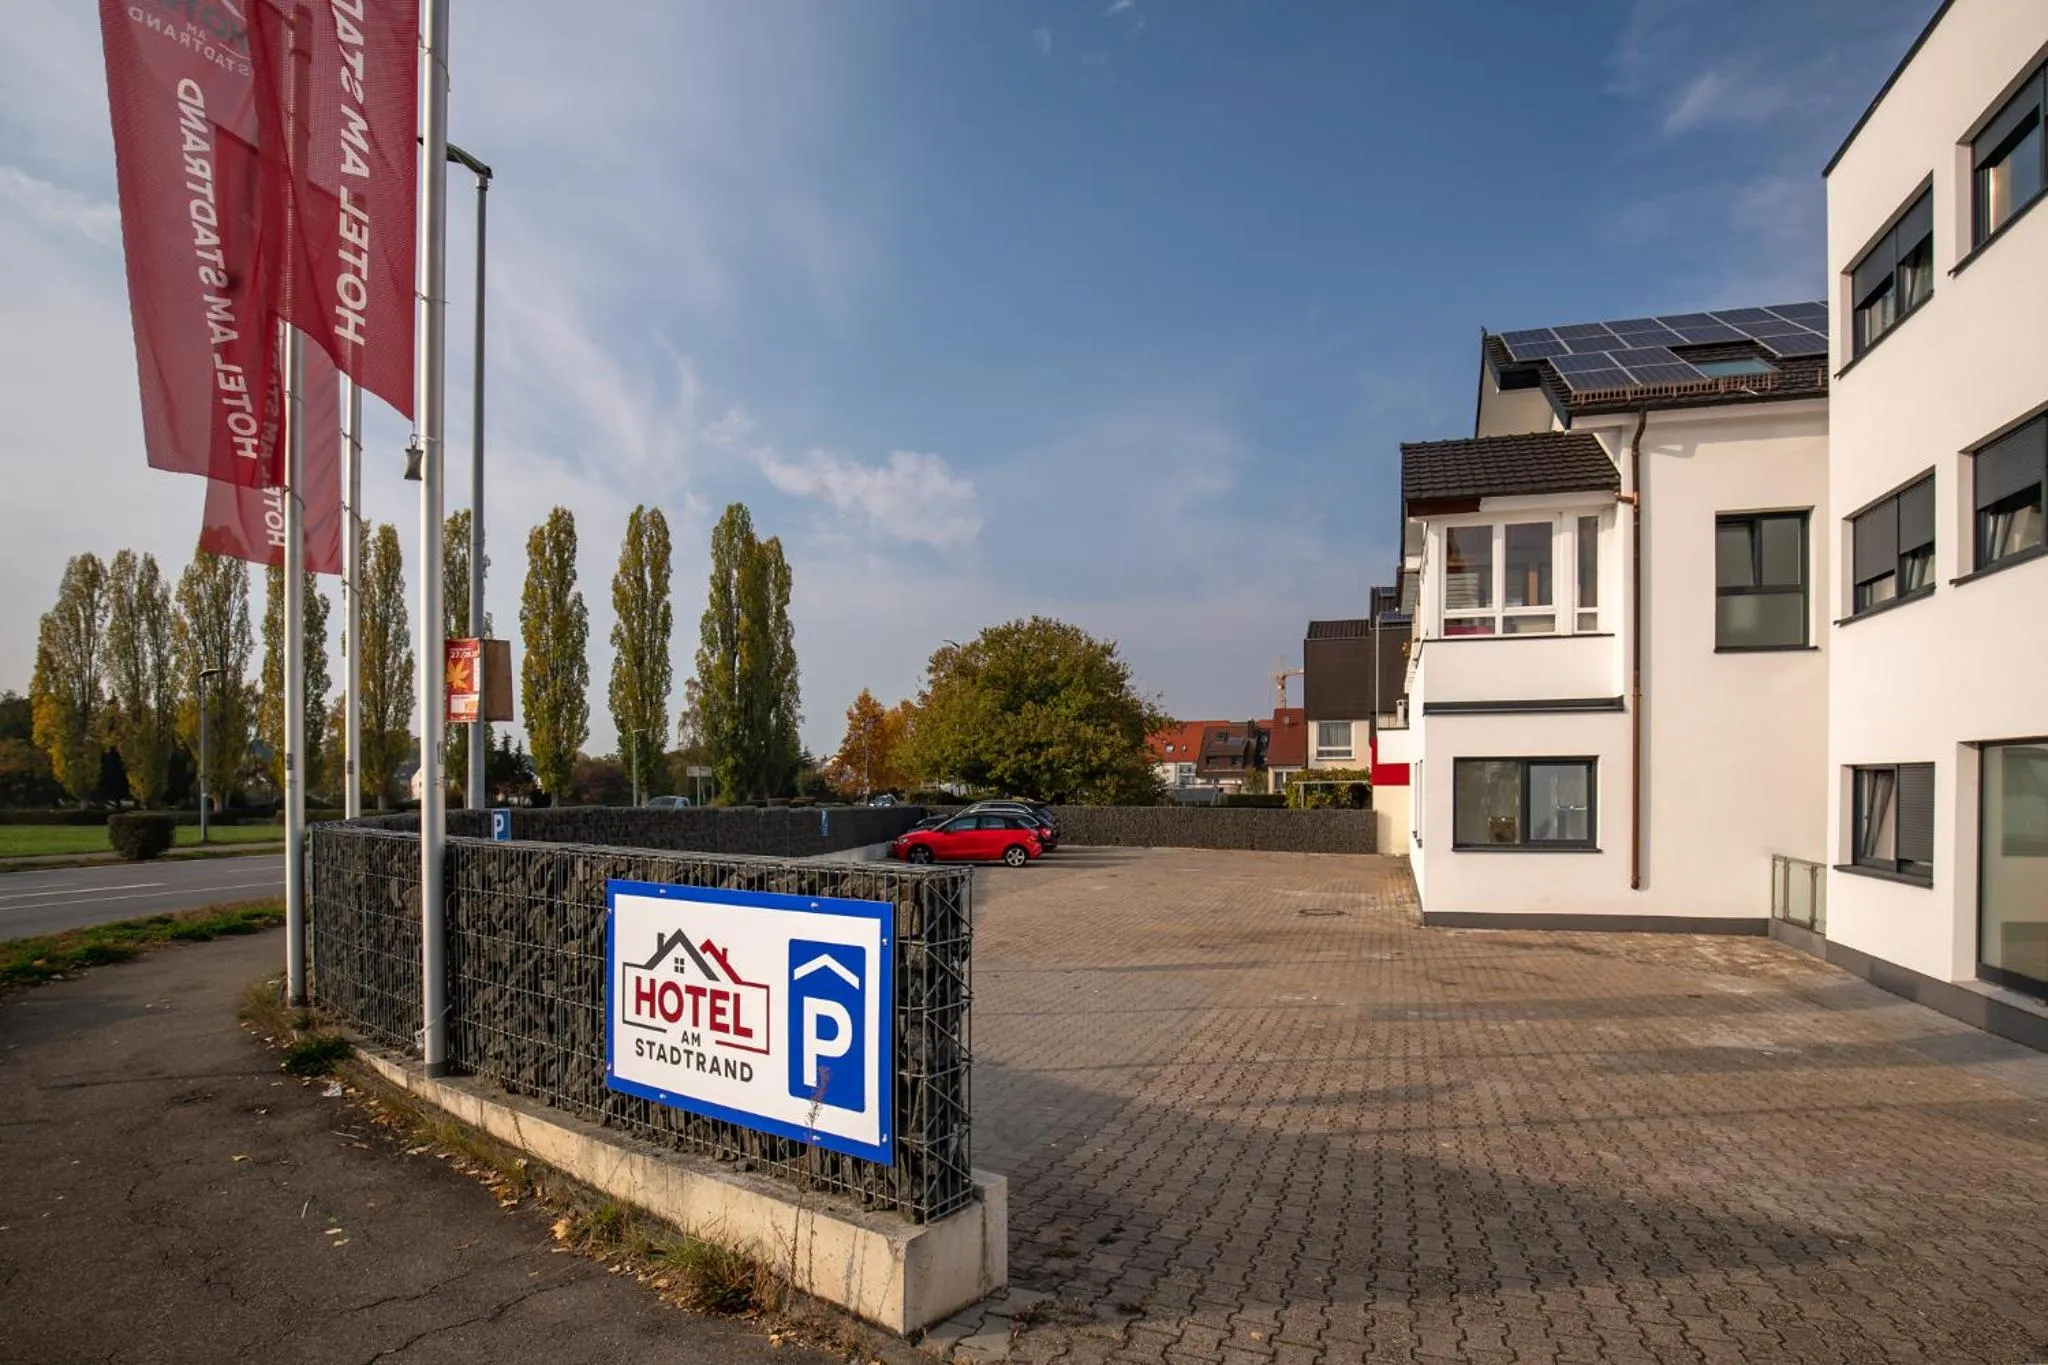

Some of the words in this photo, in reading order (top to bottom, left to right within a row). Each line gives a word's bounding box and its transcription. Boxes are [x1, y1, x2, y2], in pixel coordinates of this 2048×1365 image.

[493, 813, 504, 841] P
[635, 976, 753, 1039] HOTEL
[635, 1038, 754, 1083] STADTRAND
[681, 1030, 701, 1047] AM
[803, 996, 853, 1088] P
